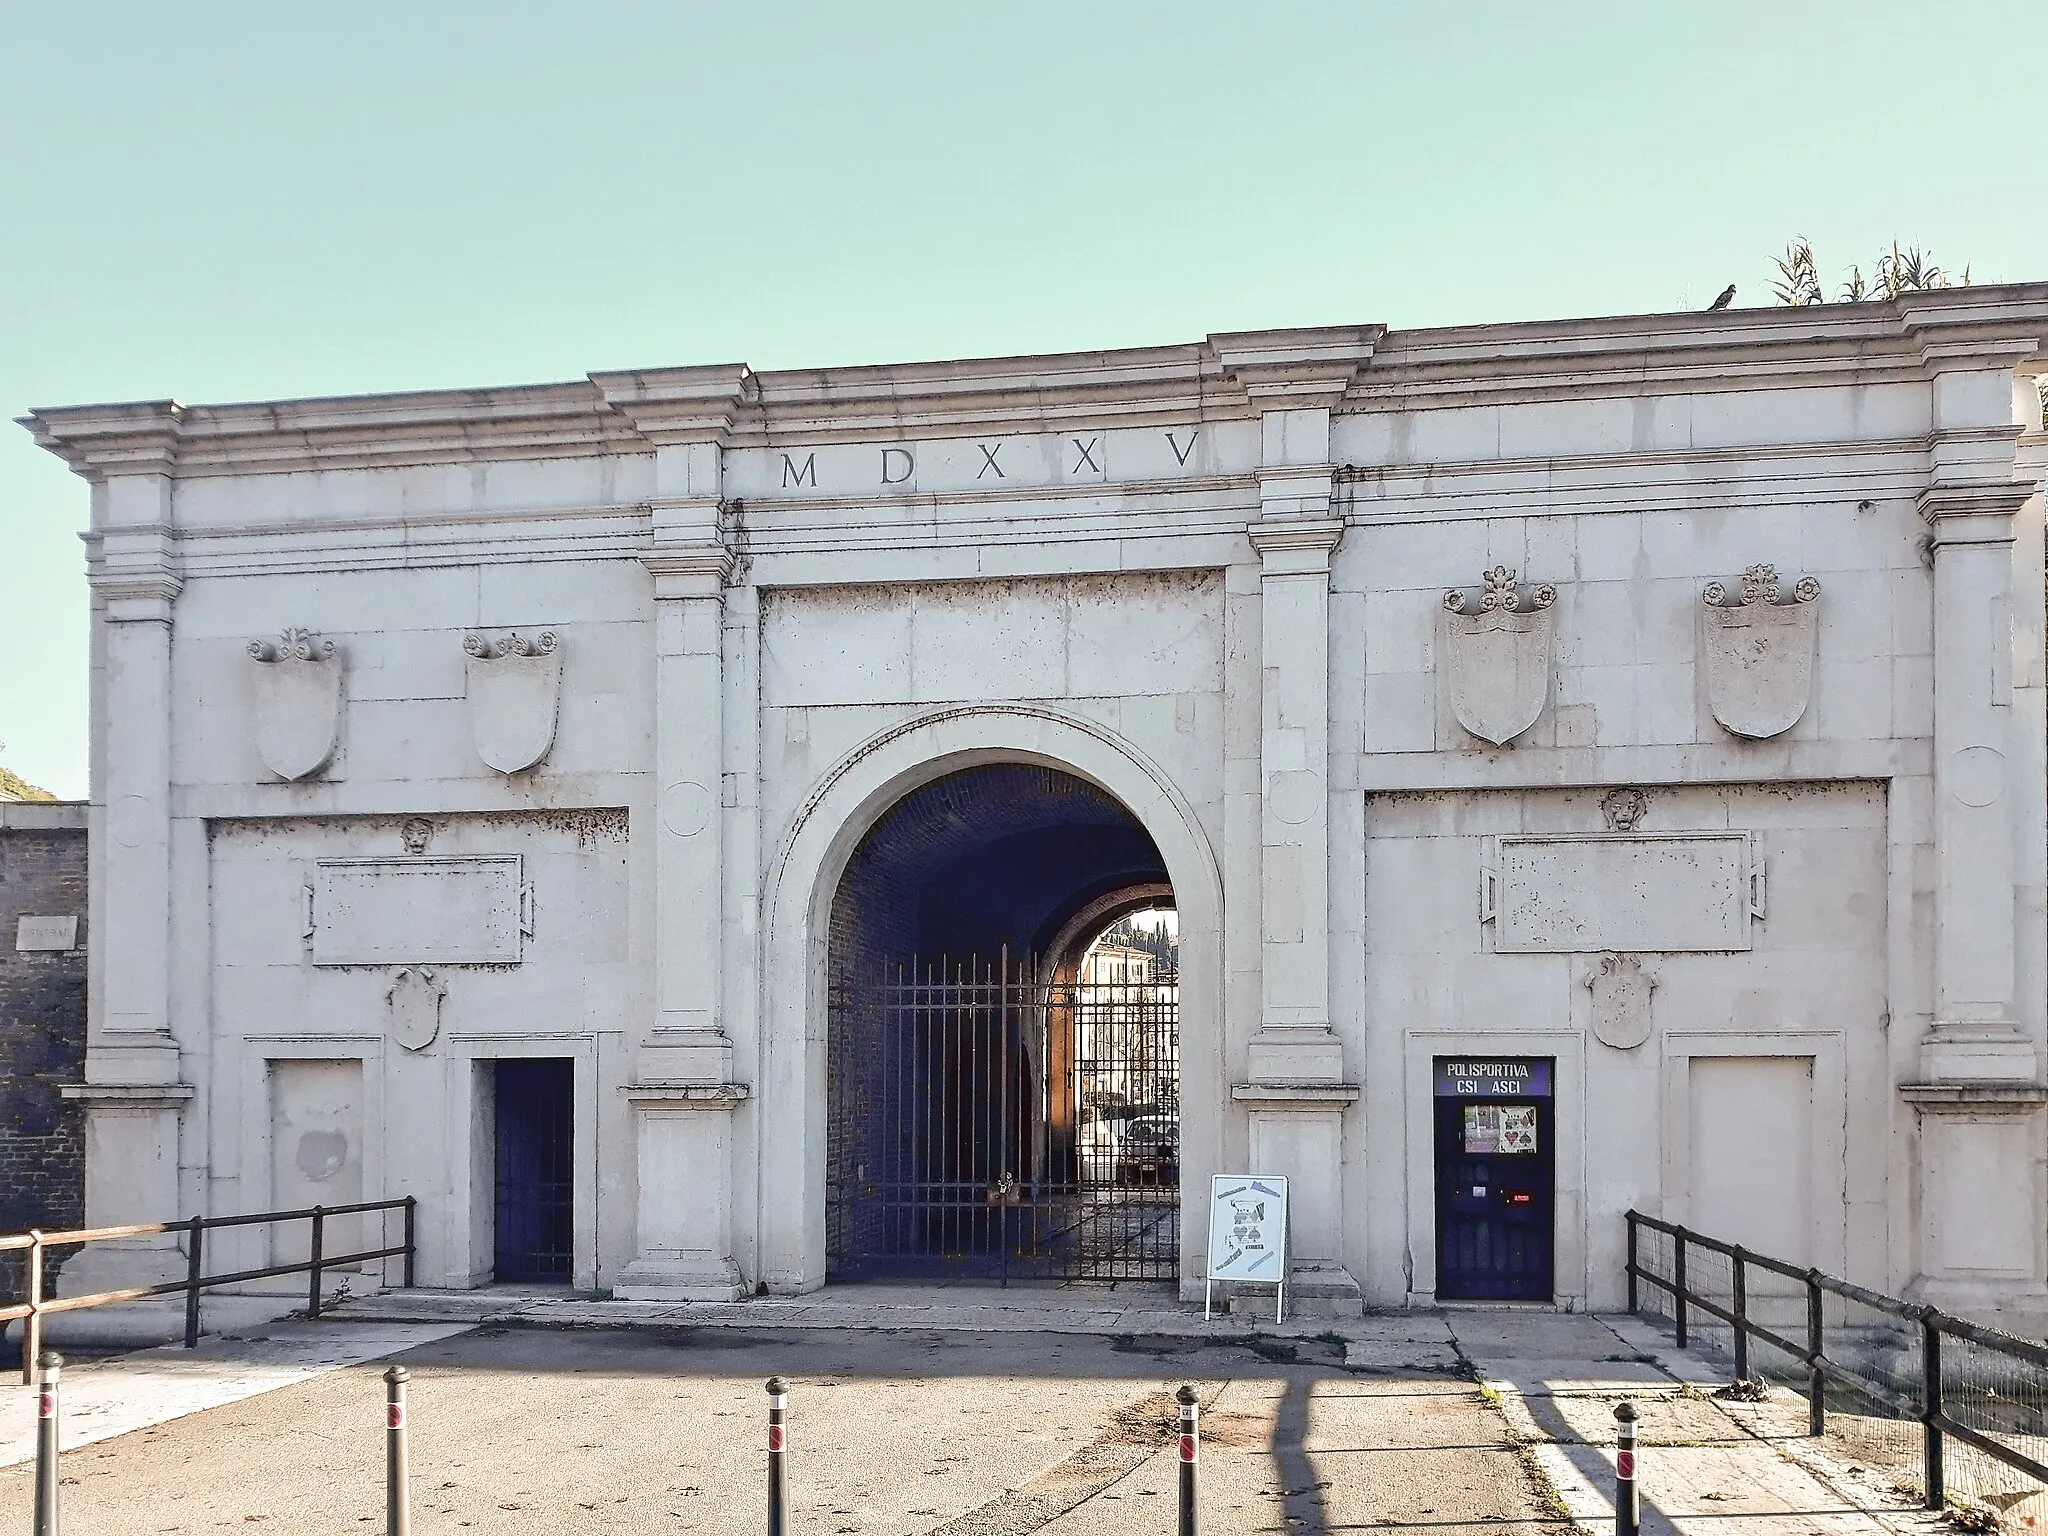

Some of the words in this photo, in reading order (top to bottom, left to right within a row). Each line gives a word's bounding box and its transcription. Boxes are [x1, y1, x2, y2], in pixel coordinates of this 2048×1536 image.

[1447, 1063, 1528, 1077] POLISPORTIVA
[1457, 1080, 1478, 1093] CSI
[1491, 1080, 1520, 1094] ASCI
